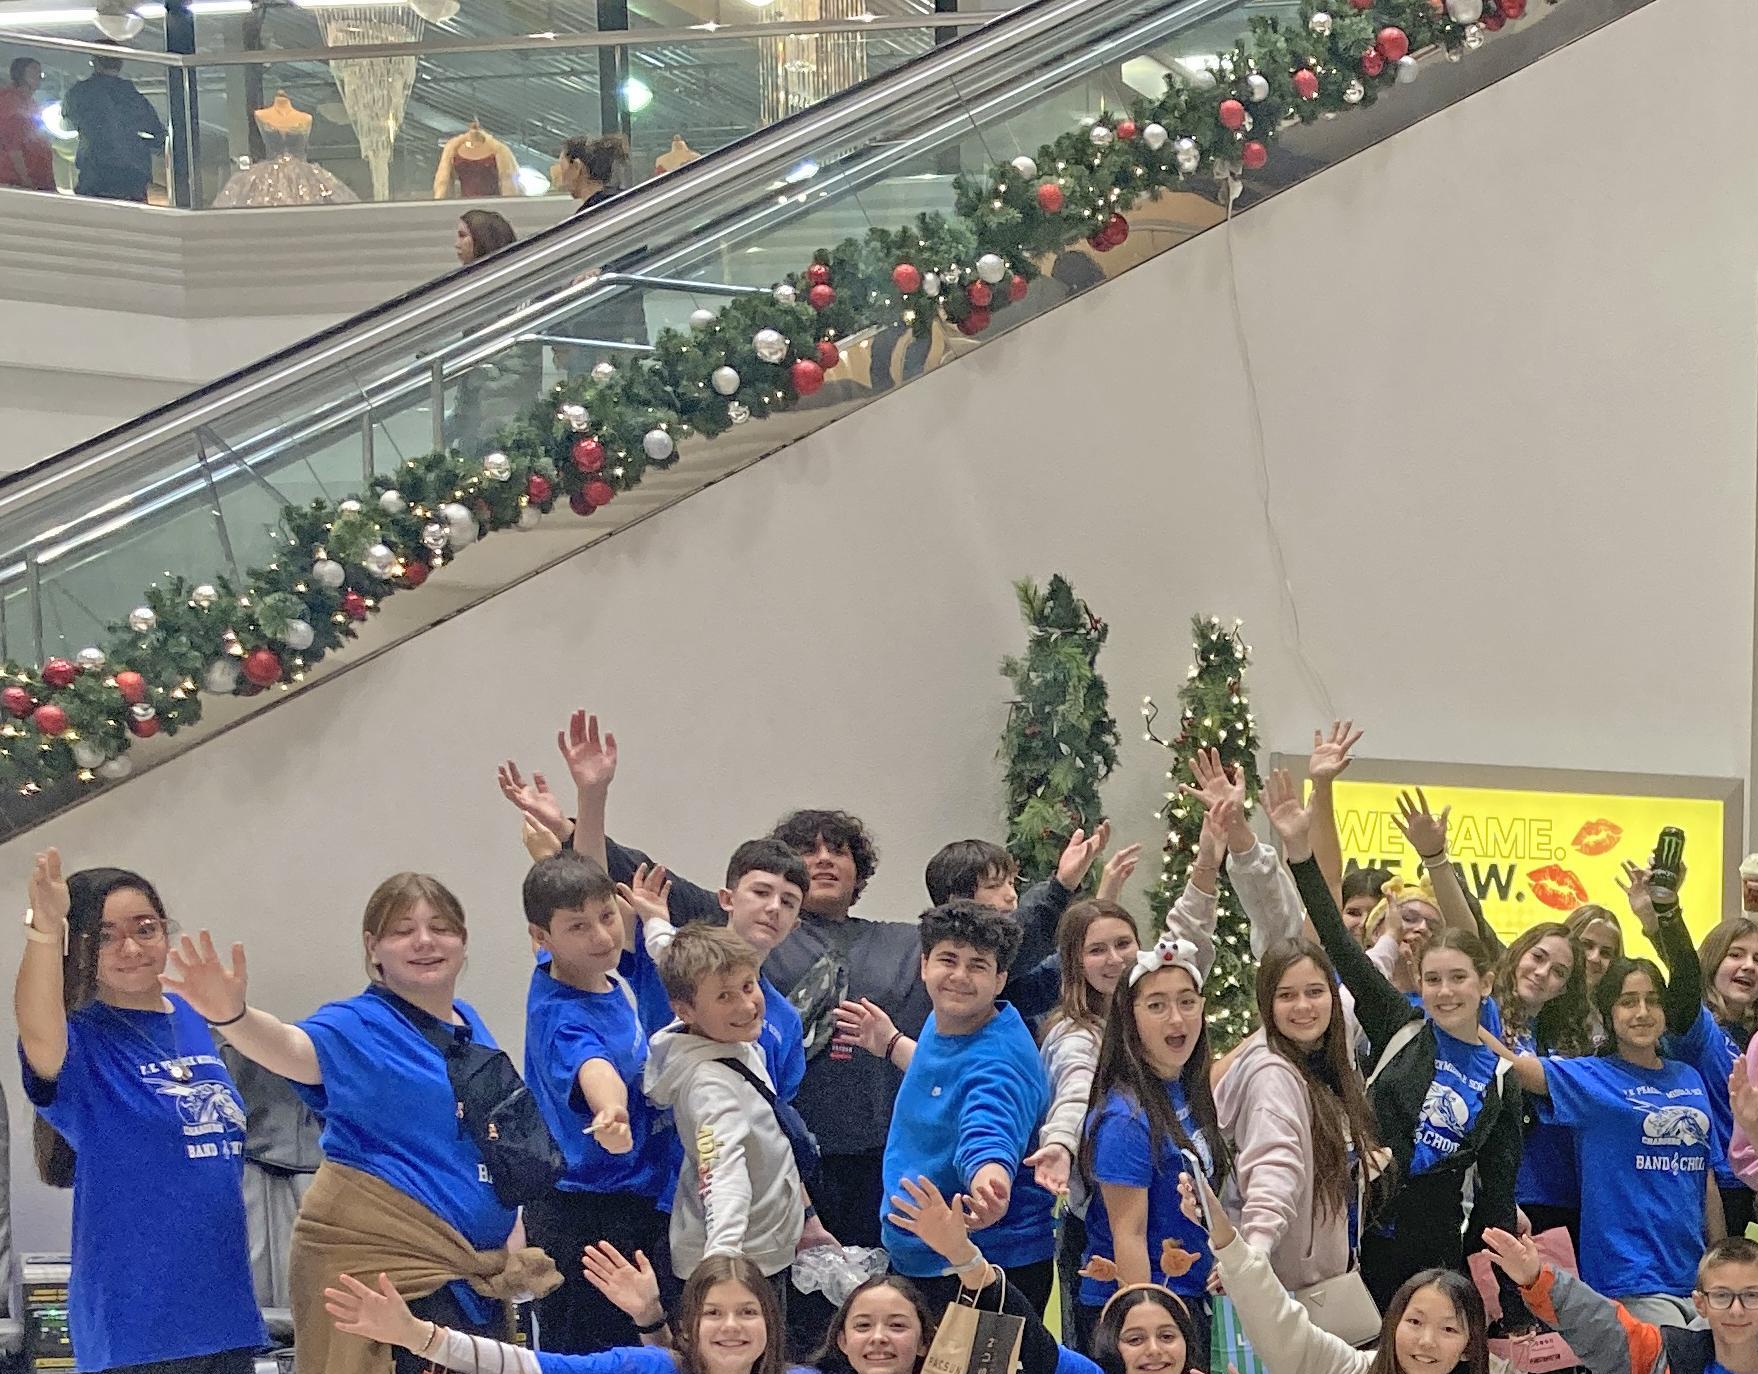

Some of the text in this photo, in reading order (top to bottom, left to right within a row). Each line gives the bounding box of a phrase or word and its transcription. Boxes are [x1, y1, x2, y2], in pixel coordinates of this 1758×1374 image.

[1335, 809, 1567, 862] WE AME.
[1416, 859, 1527, 902] W.
[1635, 1154, 1671, 1171] BAND
